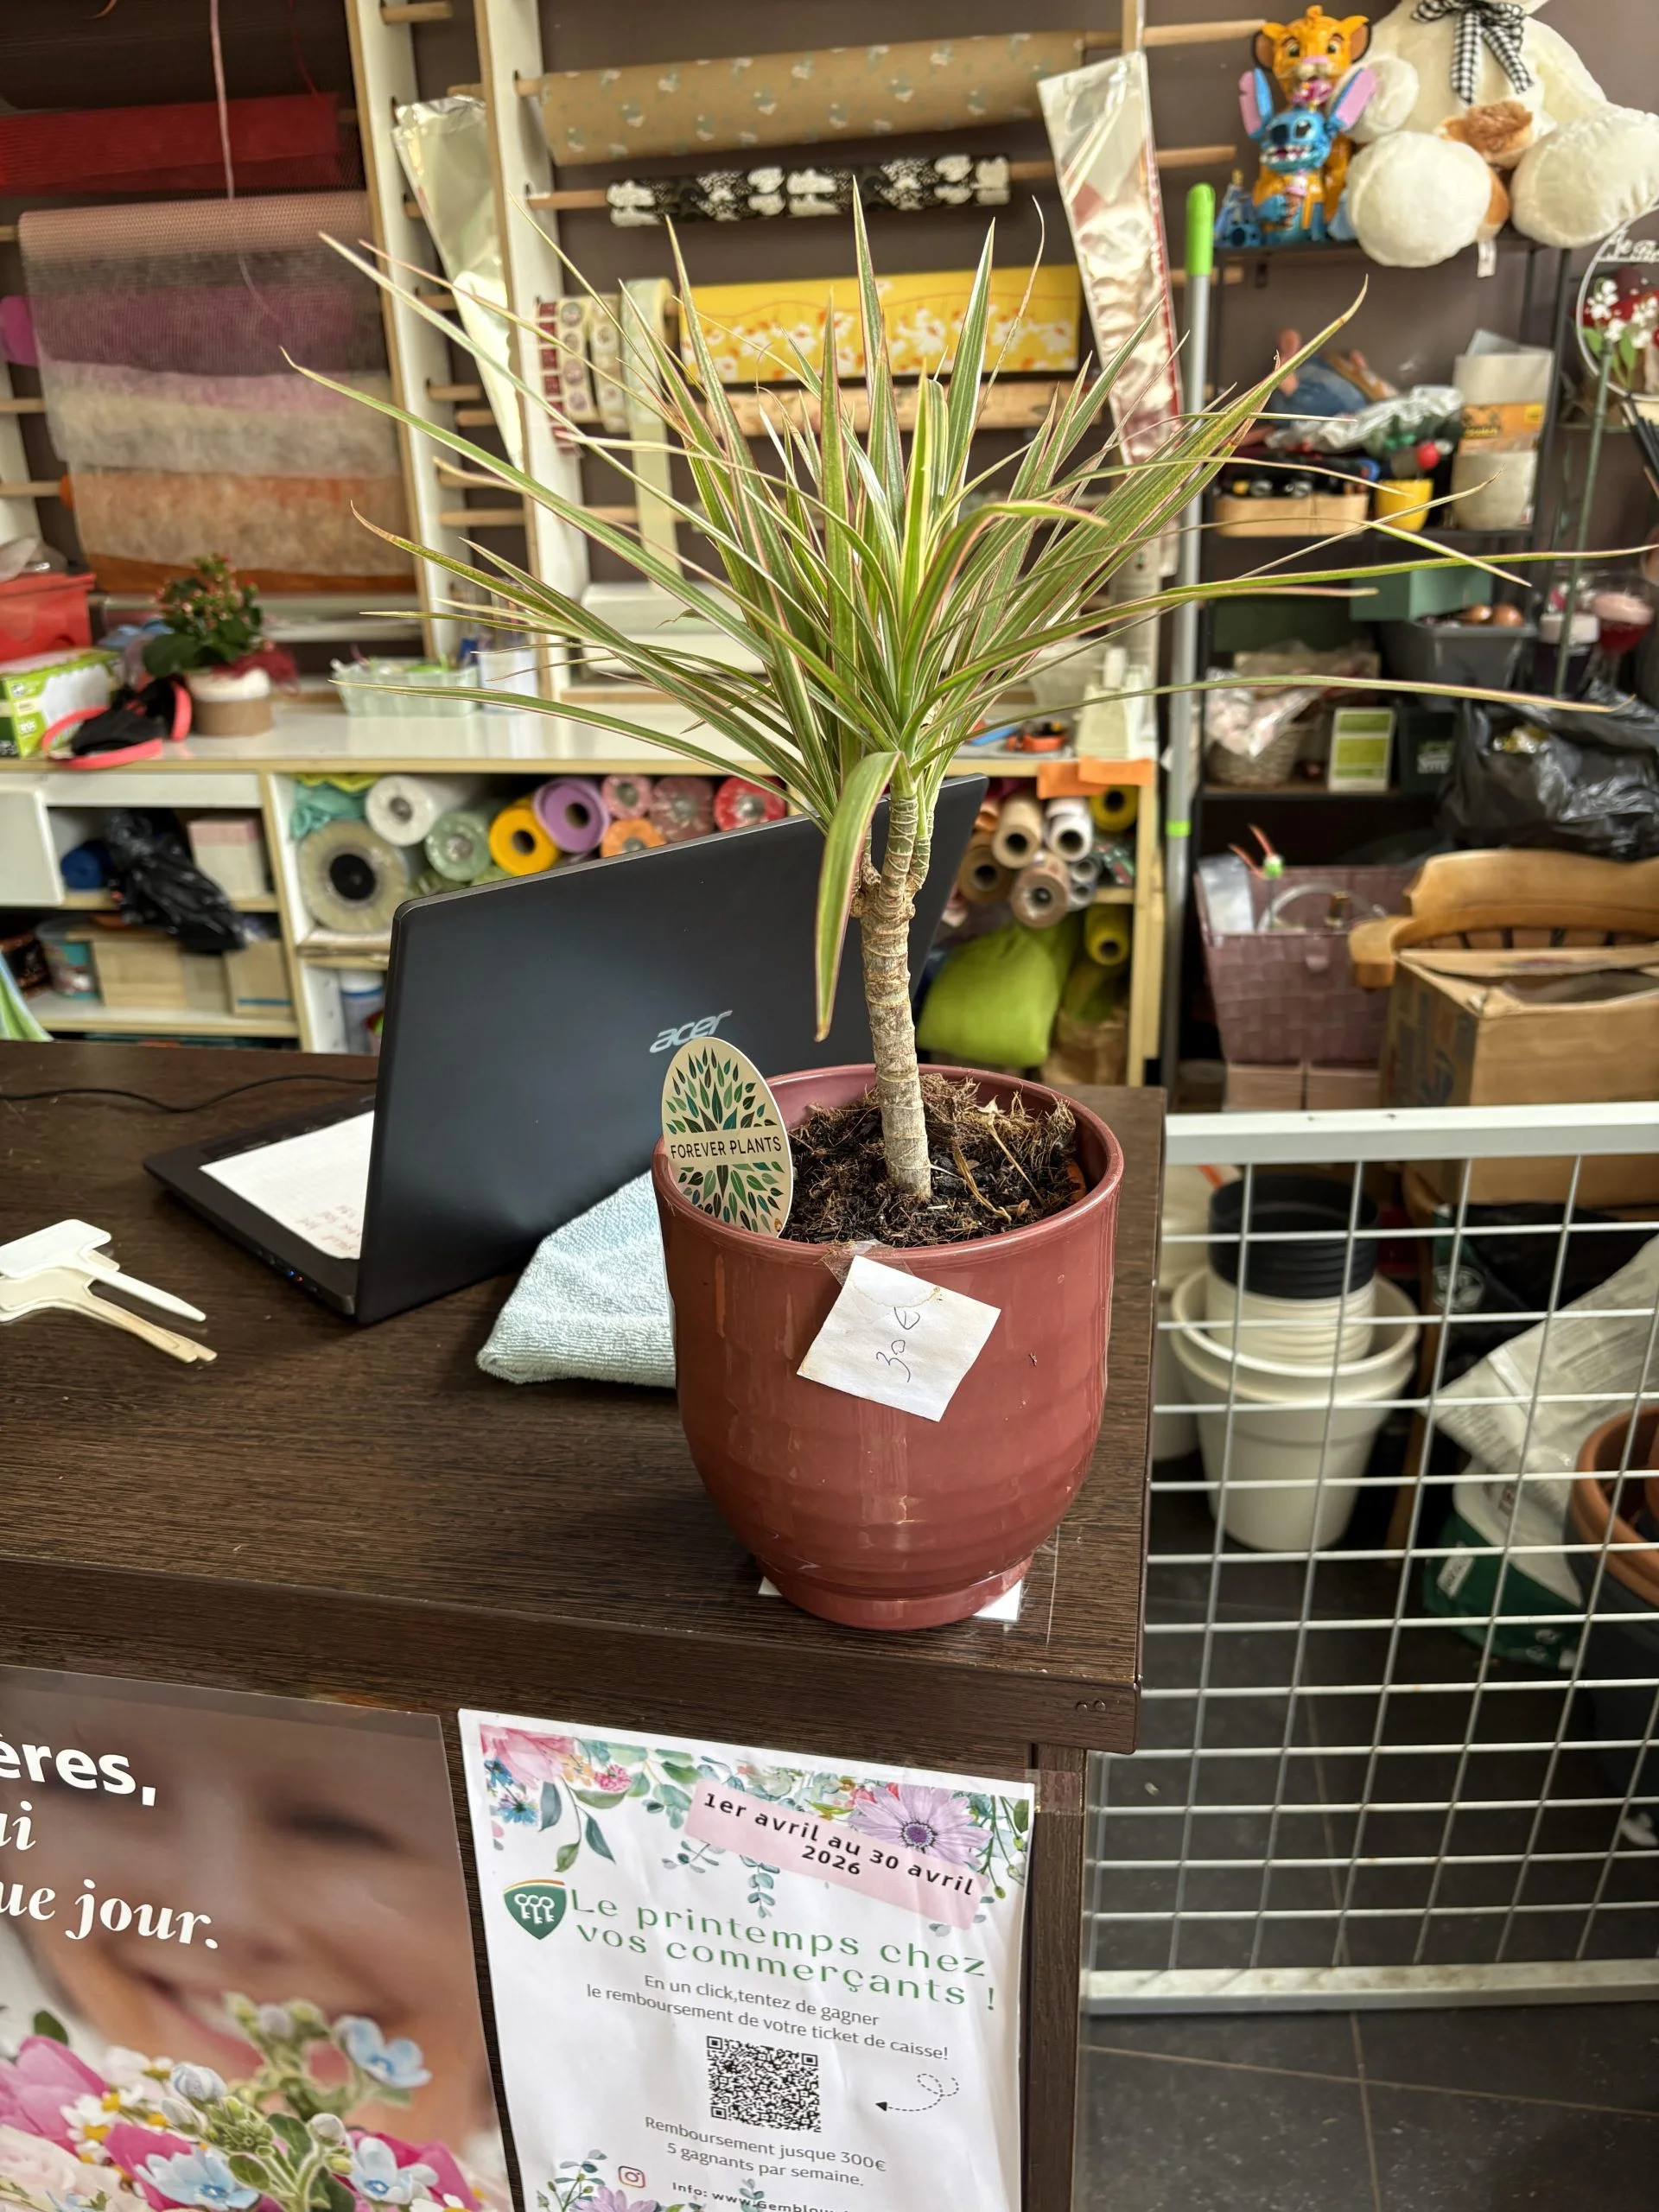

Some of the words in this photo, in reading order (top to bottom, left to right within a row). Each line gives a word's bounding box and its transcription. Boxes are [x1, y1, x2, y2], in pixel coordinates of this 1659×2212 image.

[649, 1010, 733, 1053] acer
[671, 1141, 727, 1160] FOREVER
[729, 1136, 782, 1155] PLANTS
[0, 1800, 36, 1851] i
[704, 1792, 747, 1817] 1er
[754, 1813, 819, 1842] avril
[828, 1836, 861, 1856] au
[869, 1849, 899, 1869] 30
[907, 1864, 974, 1896] avril
[802, 1845, 861, 1875] 2026
[65, 1878, 219, 1949] jour.
[571, 1889, 617, 1916] Le
[638, 1907, 860, 1957] printemps
[880, 1942, 986, 1977] chez
[576, 1924, 647, 1954] vos
[666, 1942, 965, 2005] commerçants
[588, 1984, 602, 1998] le
[606, 1989, 734, 2023] remboursement
[739, 2012, 759, 2027] de
[763, 2018, 807, 2037] votre
[812, 2025, 860, 2044] ticket
[864, 2034, 886, 2049] de
[890, 2040, 949, 2061] caisse!
[645, 1974, 664, 1990] En
[670, 1981, 691, 1993] un
[796, 1999, 817, 2015] de
[821, 2006, 880, 2025] gagner
[645, 2117, 775, 2155] Remboursement
[779, 2145, 836, 2163] jusque
[841, 2152, 887, 2172] 300€
[667, 2142, 677, 2154] 5
[681, 2148, 754, 2171] gagnants
[759, 2164, 786, 2177] par
[791, 2168, 864, 2187] semaine.
[672, 2182, 708, 2197] Info:
